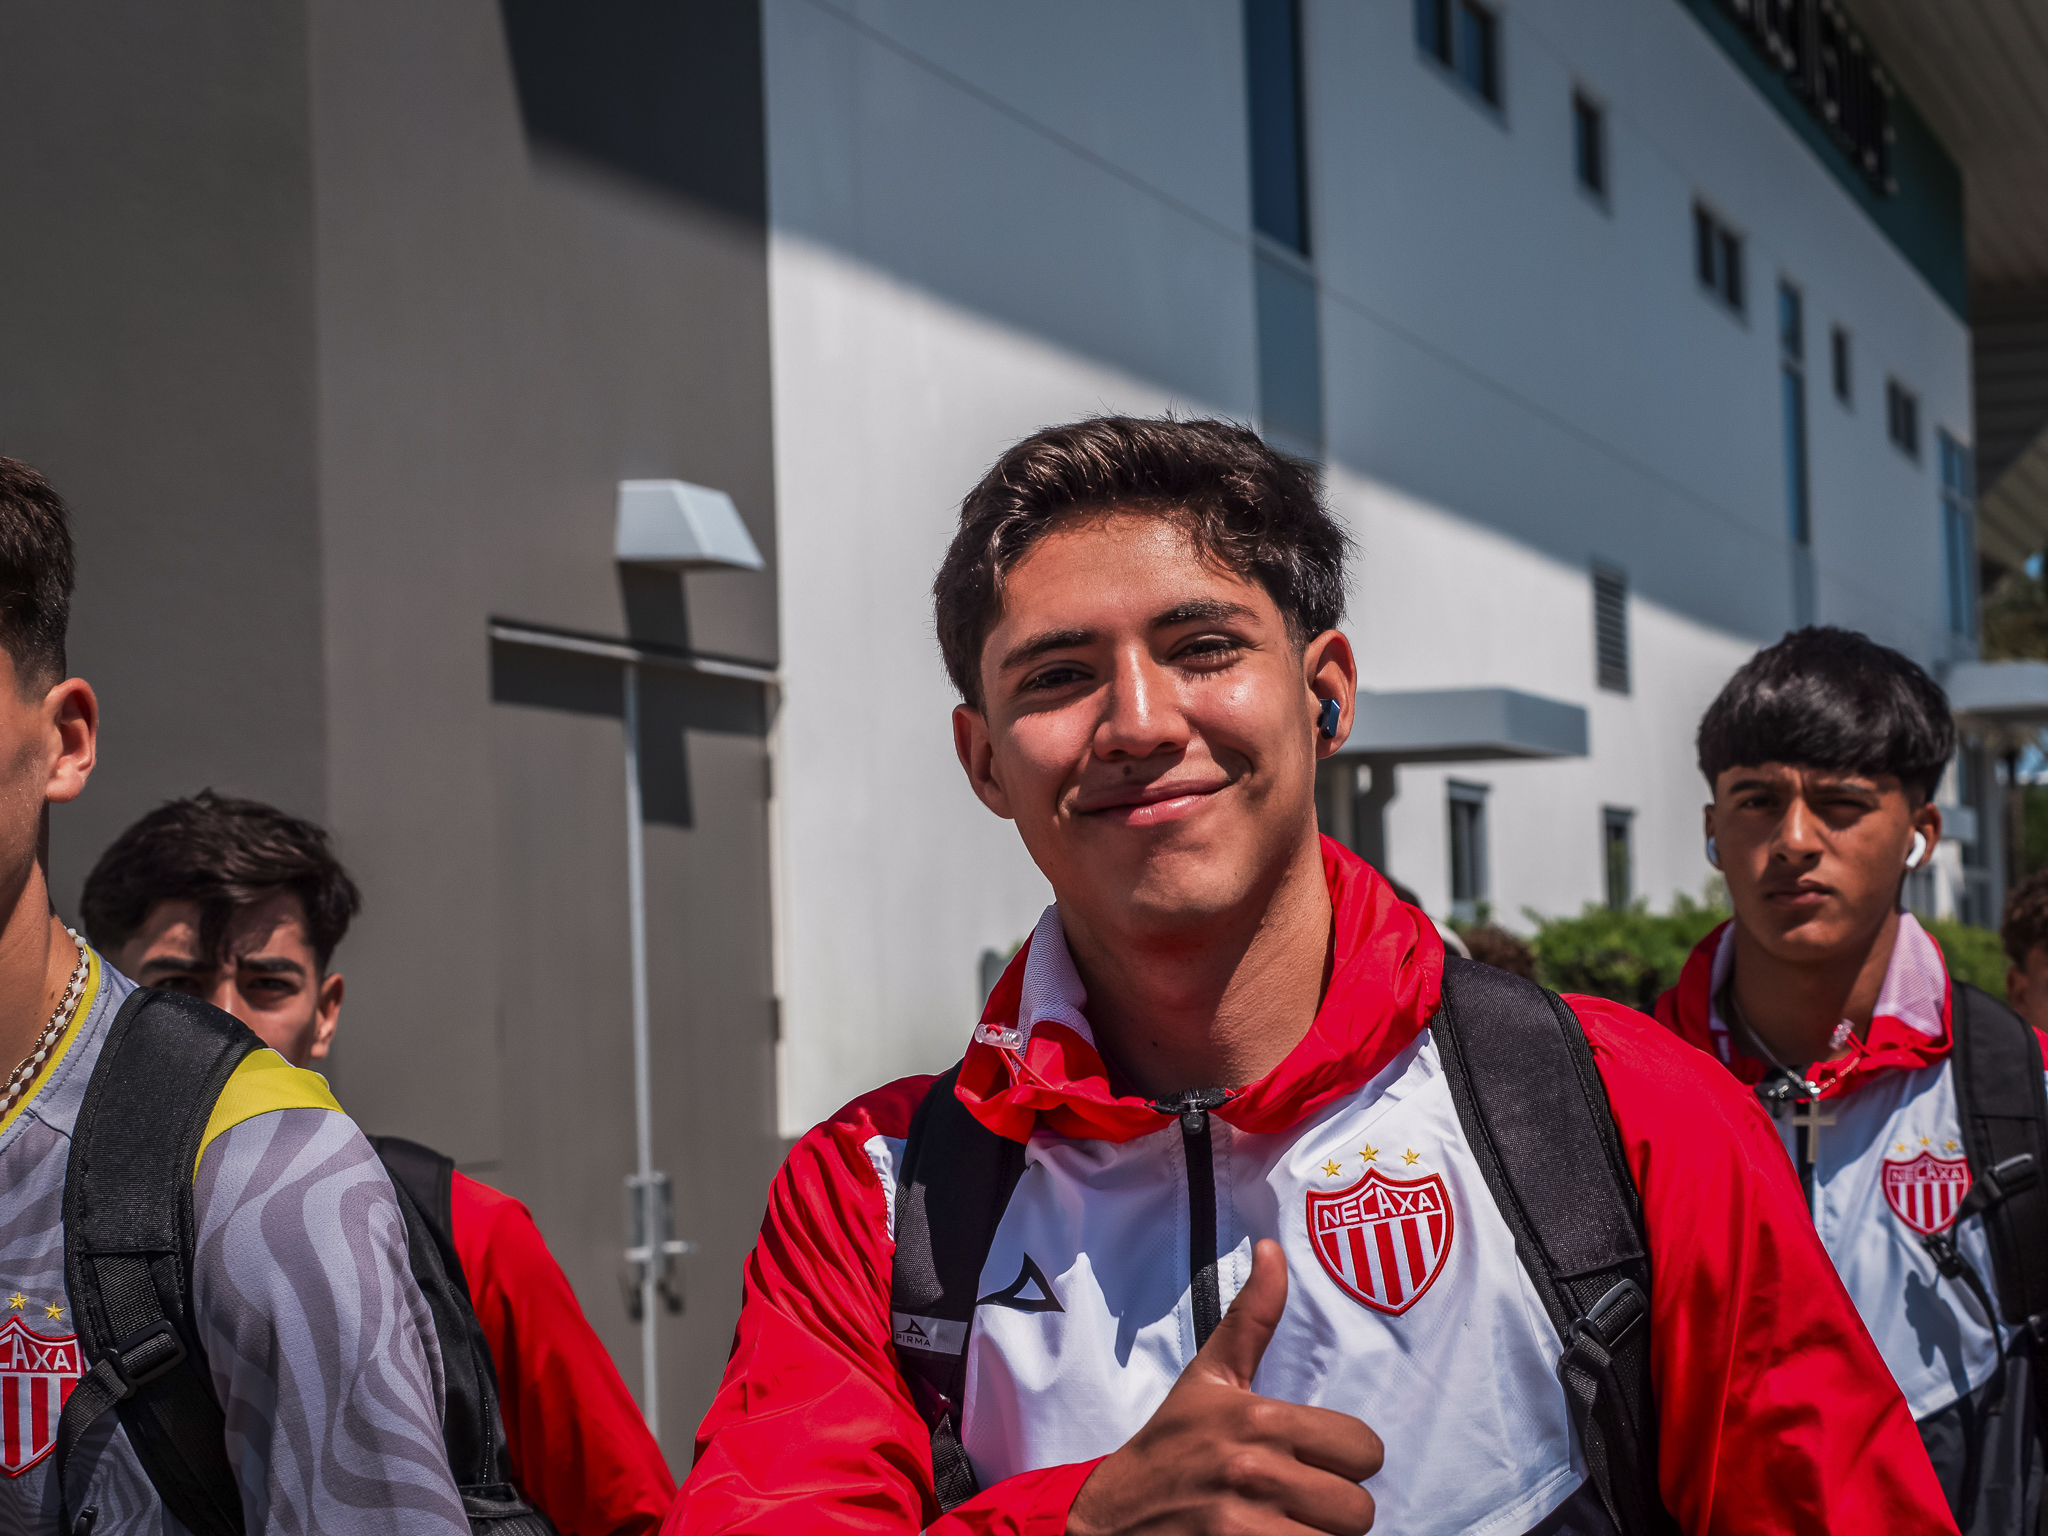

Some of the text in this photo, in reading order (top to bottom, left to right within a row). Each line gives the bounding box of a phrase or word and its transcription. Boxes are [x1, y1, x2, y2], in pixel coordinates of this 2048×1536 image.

[1891, 1161, 1961, 1180] NECAXA
[1322, 1186, 1435, 1228] NECAXA
[895, 1333, 931, 1347] PIRMA
